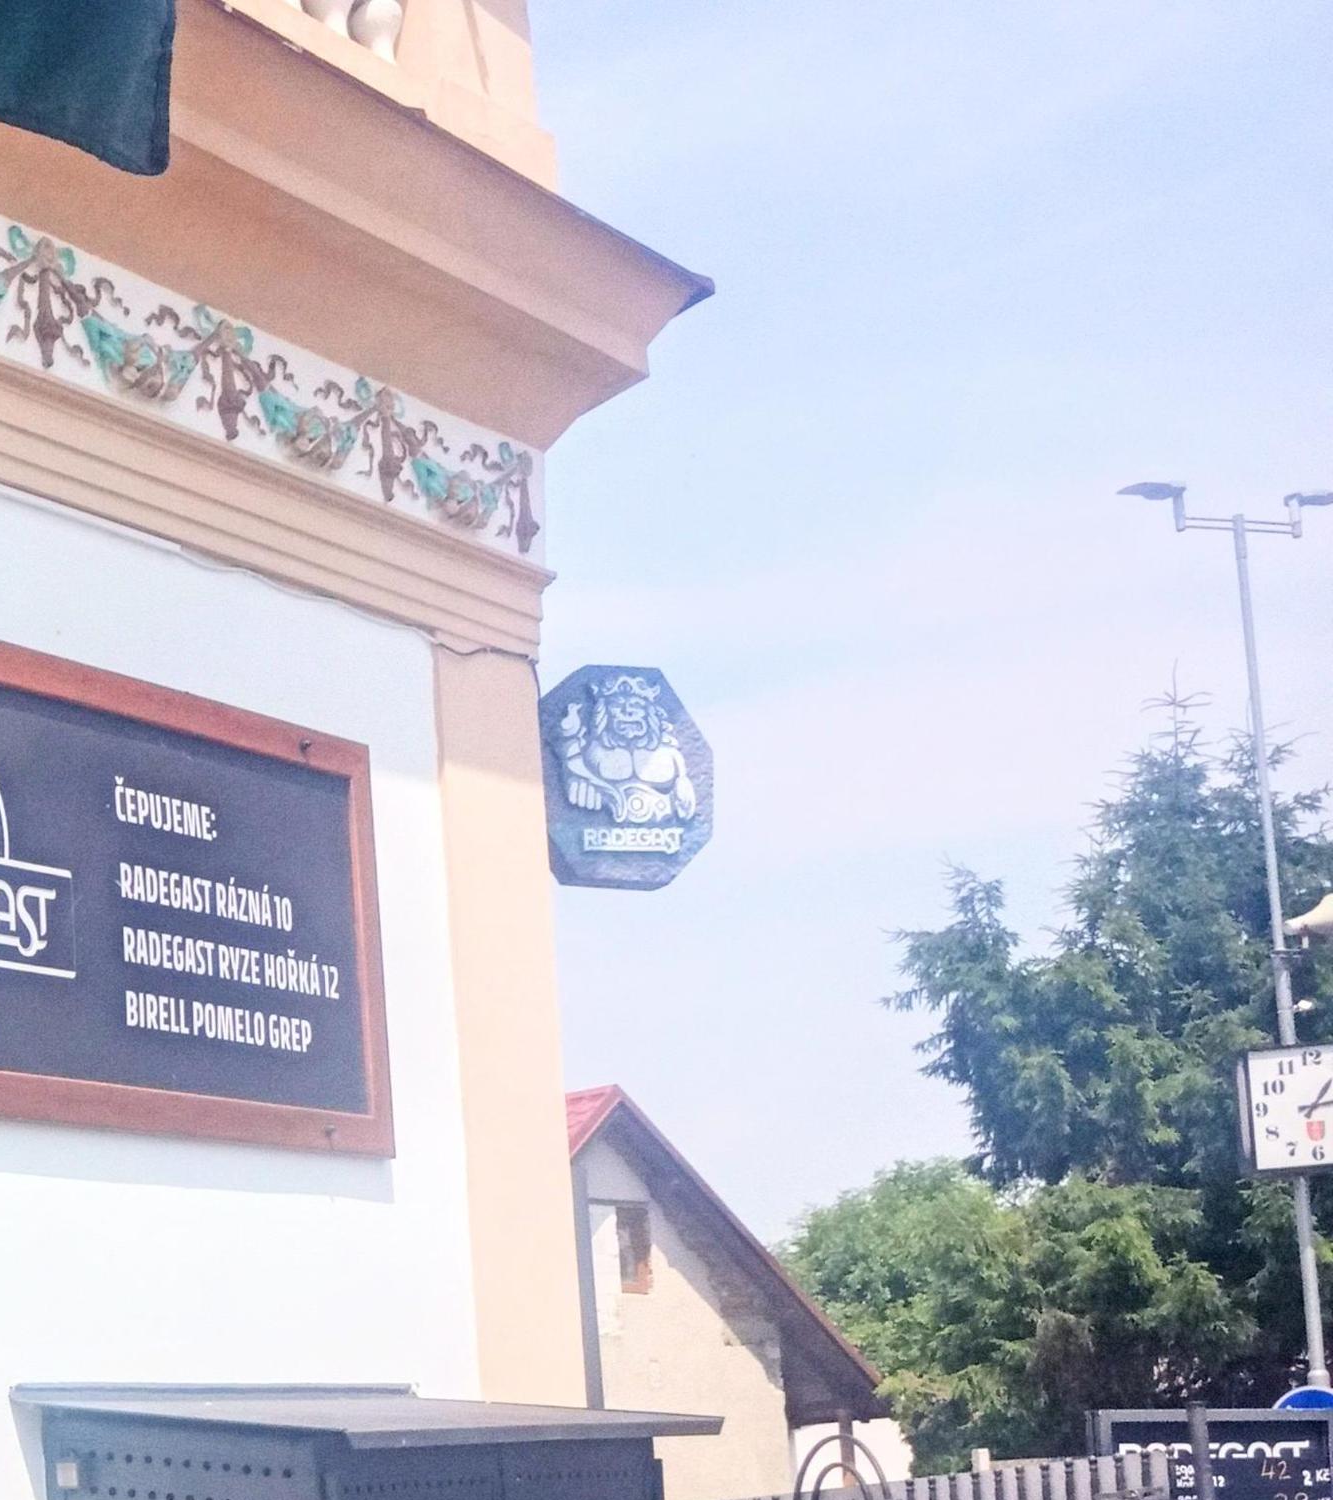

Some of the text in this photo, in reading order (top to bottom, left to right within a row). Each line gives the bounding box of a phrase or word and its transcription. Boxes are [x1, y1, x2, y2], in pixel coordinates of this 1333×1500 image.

[114, 775, 217, 841] ČEPUJEME:
[583, 826, 685, 855] RADEGAST
[119, 862, 293, 932] RADEGAST RÁZNÁ 10
[123, 926, 340, 1000] RADEGAST RYZE HOŘKÁ 12
[125, 990, 313, 1053] BIRELL POMELO GREP
[1312, 1145, 1325, 1161] 6
[1261, 1459, 1292, 1480] 42
[1315, 1468, 1331, 1482] Kč
